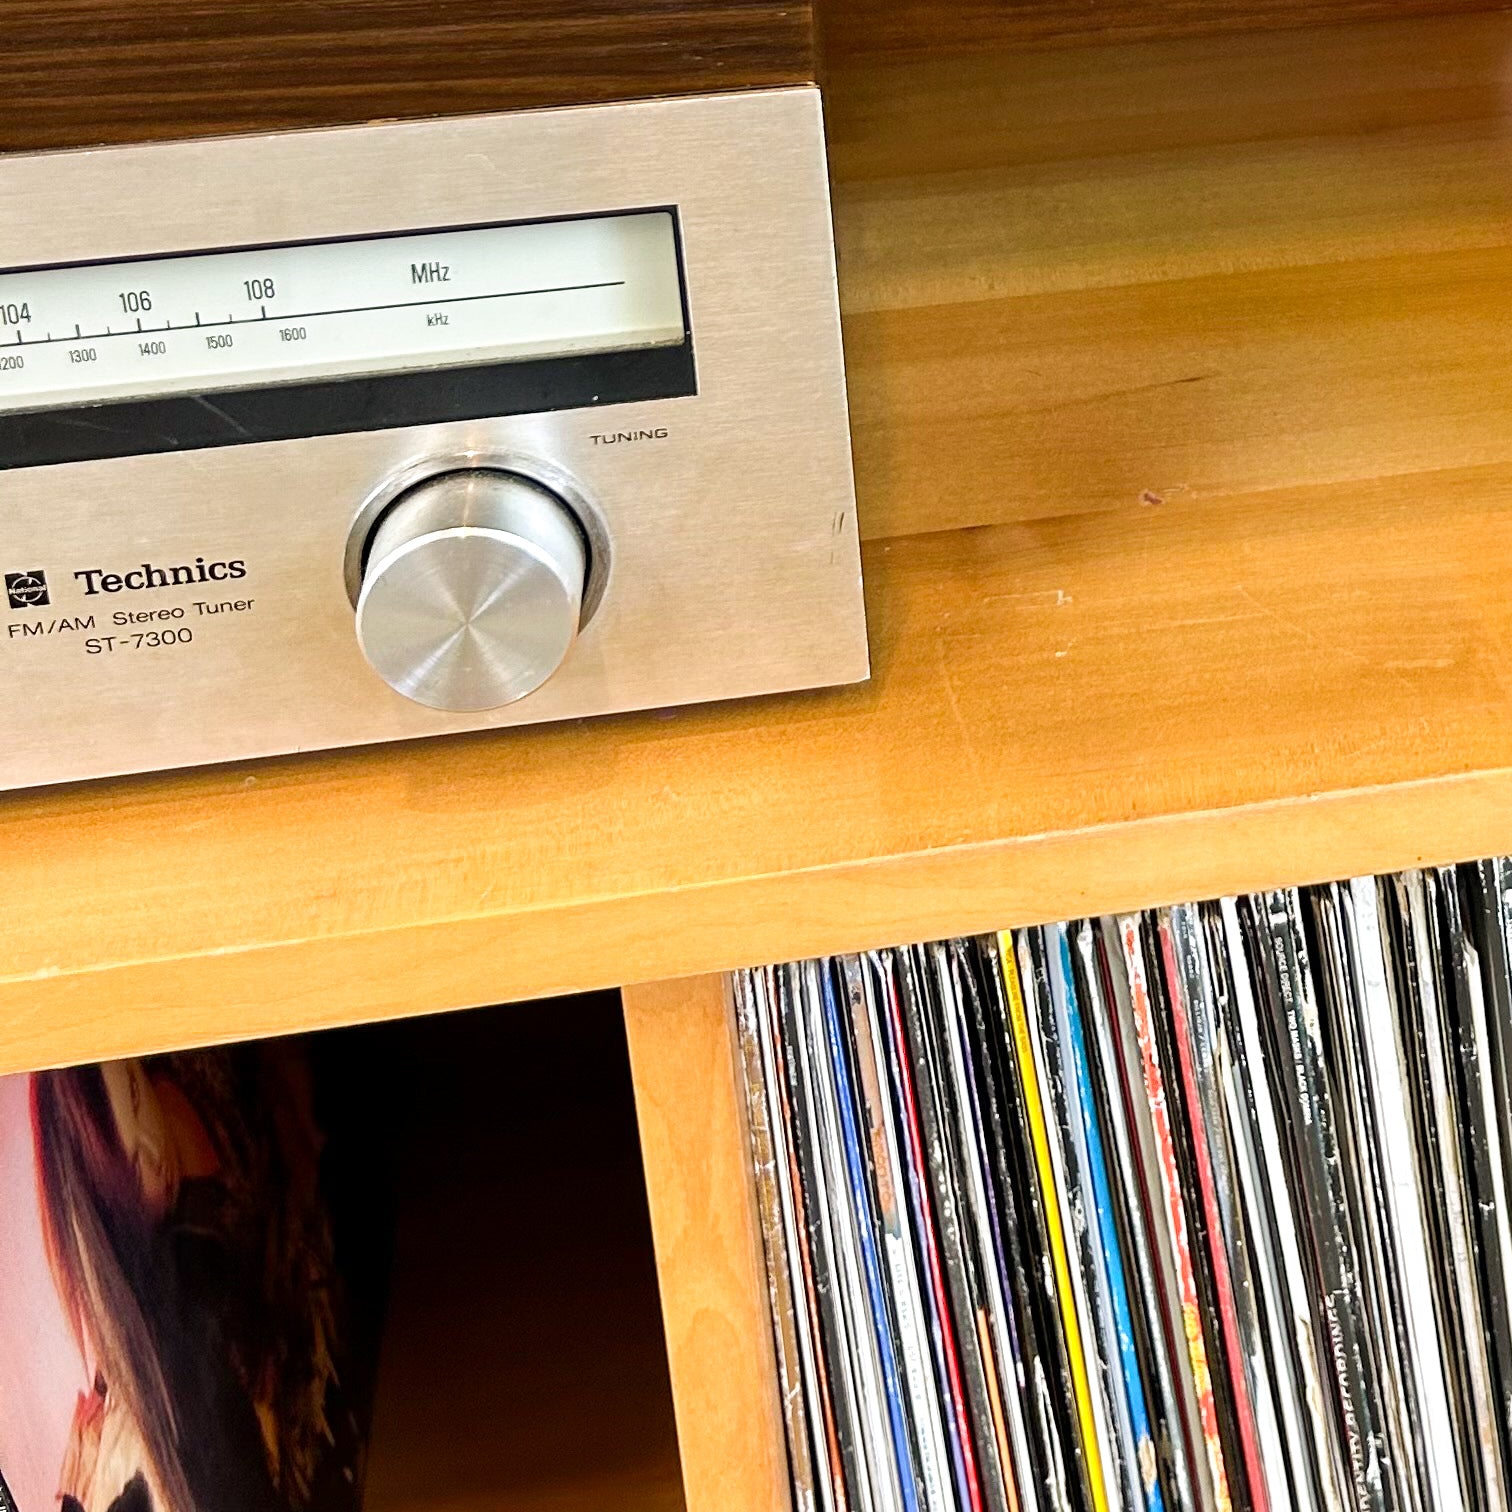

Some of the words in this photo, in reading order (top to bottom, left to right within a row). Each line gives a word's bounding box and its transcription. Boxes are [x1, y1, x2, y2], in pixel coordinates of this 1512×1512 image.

[0, 302, 31, 326] 104
[119, 290, 152, 313] 106
[243, 278, 275, 300] 108
[411, 262, 450, 284] MHz
[0, 355, 24, 370] 200
[69, 348, 97, 364] 1300
[138, 341, 166, 356] 1400
[206, 334, 233, 349] 1500
[279, 327, 306, 342] 1600
[427, 312, 449, 327] kHz
[590, 428, 668, 445] TUNING
[74, 557, 247, 595] Technics
[8, 616, 96, 639] FM/AM
[112, 607, 185, 626] Stereo
[193, 599, 255, 616] Tuner
[85, 627, 193, 654] ST-7300
[1275, 936, 1289, 972] SOURCE
[1281, 973, 1294, 1003] DIRECT
[1288, 1009, 1298, 1029] TWO
[1290, 1030, 1303, 1059] MASKS
[1296, 1065, 1308, 1092] BLACK
